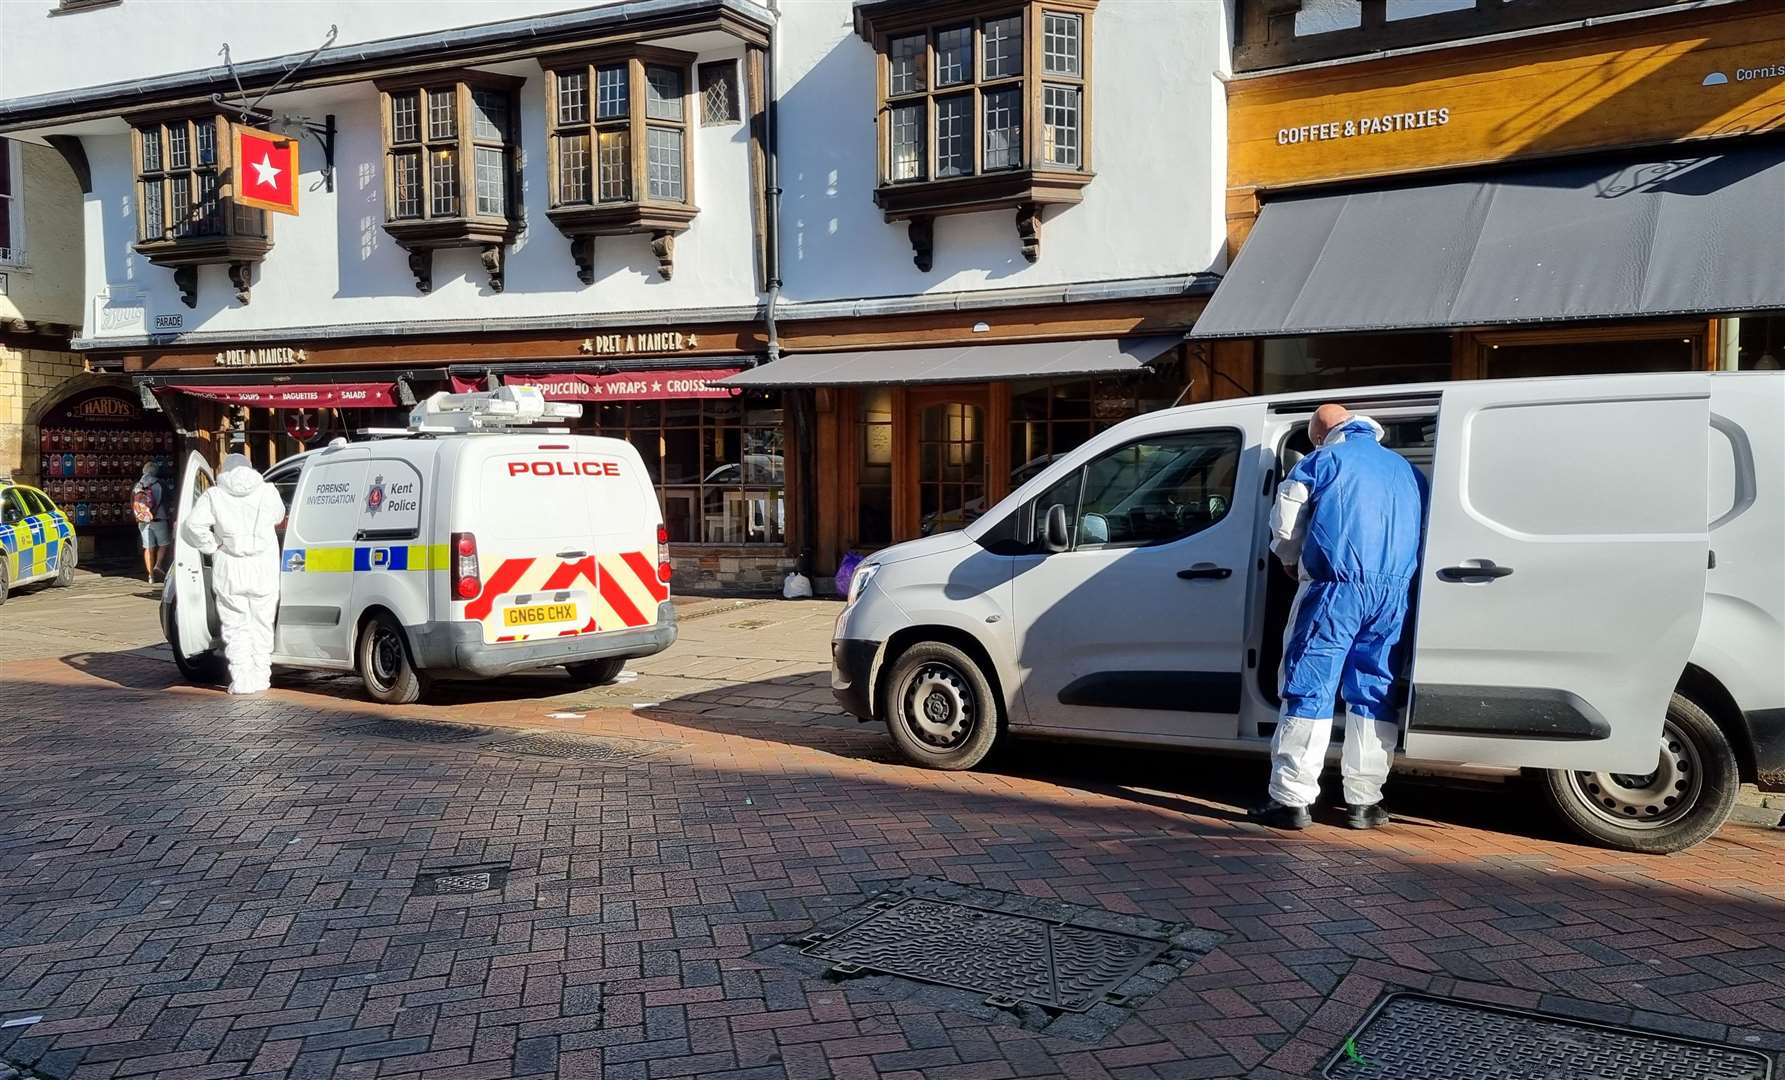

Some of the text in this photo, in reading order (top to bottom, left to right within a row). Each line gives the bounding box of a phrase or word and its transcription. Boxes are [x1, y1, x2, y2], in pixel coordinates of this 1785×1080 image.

[1278, 107, 1450, 145] COFFEE & PASTRIES
[156, 316, 182, 328] PARADE
[596, 332, 684, 353] PRET A MANGER
[226, 347, 296, 365] PRET A MANGER
[606, 380, 648, 395] WRAPS
[341, 390, 367, 400] SALADS
[507, 461, 621, 477] POLICE
[316, 482, 350, 494] FORENSIC
[390, 482, 413, 495] Kent
[306, 493, 356, 505] INVESTIGATION
[388, 499, 417, 512] Police
[509, 604, 573, 624] GN66 CHX
